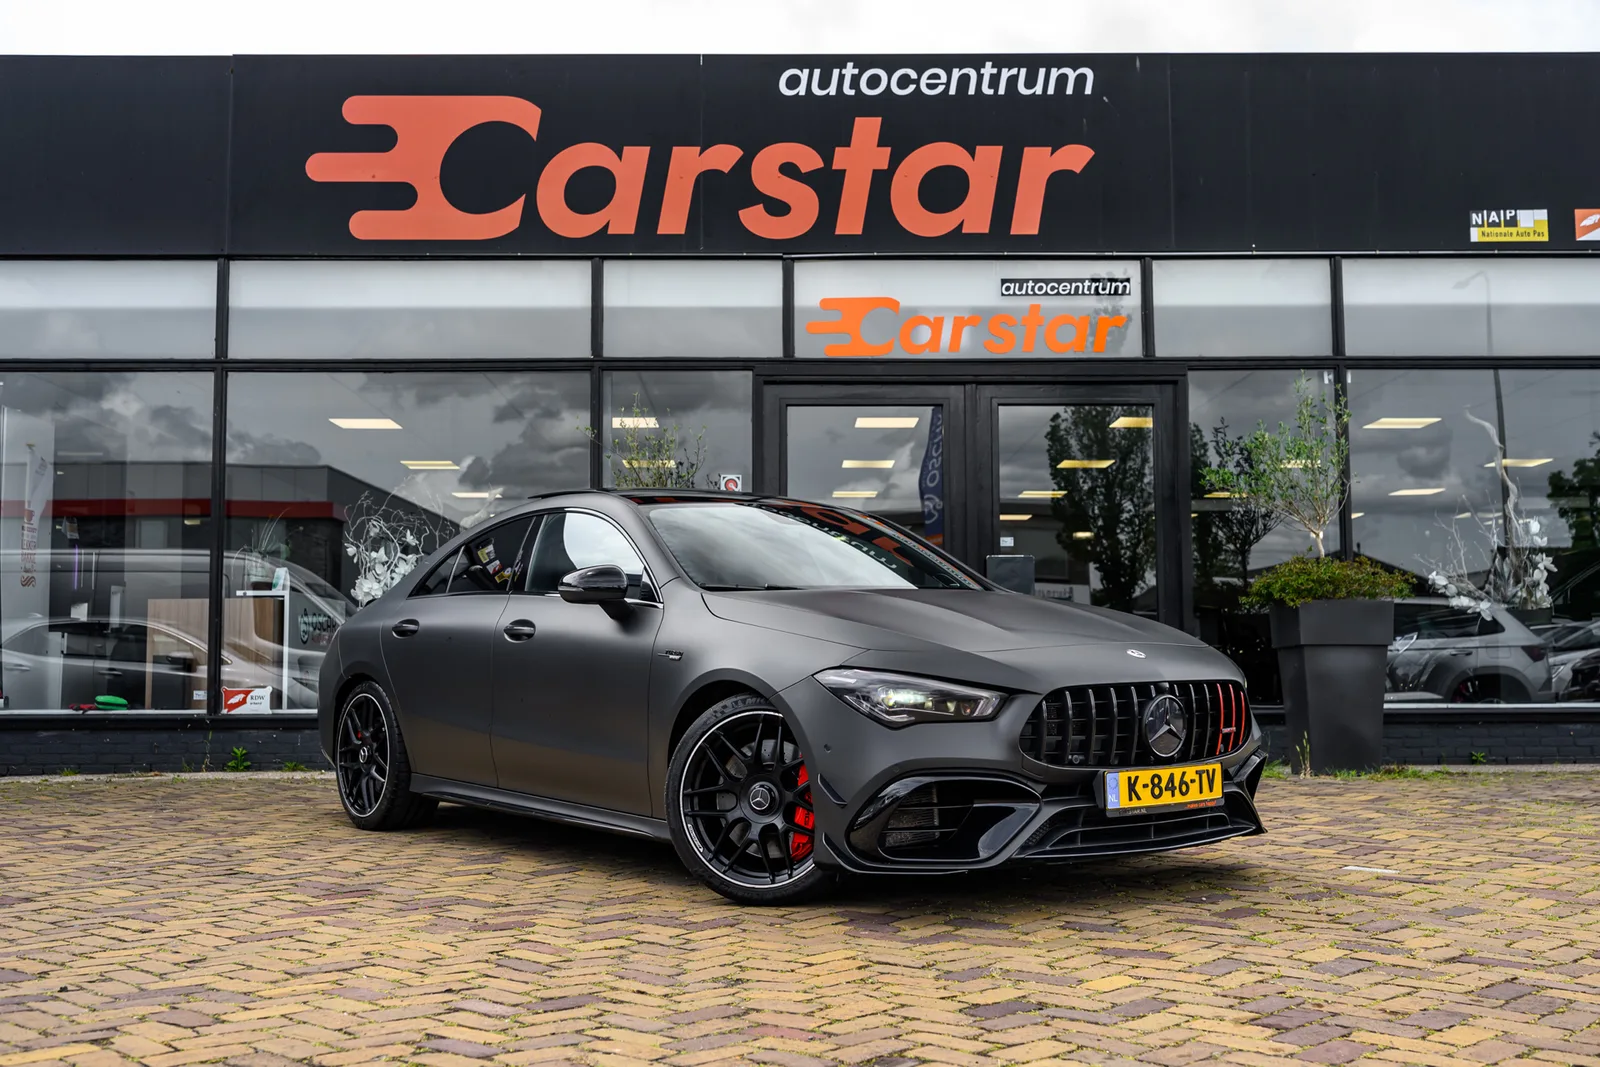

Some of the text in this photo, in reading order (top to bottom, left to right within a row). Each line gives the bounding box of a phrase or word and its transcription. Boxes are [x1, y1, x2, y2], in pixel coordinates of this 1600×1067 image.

[778, 61, 1095, 96] autocentrum
[305, 95, 1095, 240] Carstar
[1471, 209, 1516, 225] NAP
[1481, 229, 1545, 238] Nationale Auto Pas
[1001, 279, 1130, 295] autocentrum
[805, 296, 1128, 357] Carstar
[1108, 768, 1216, 803] NL K-846-TV
